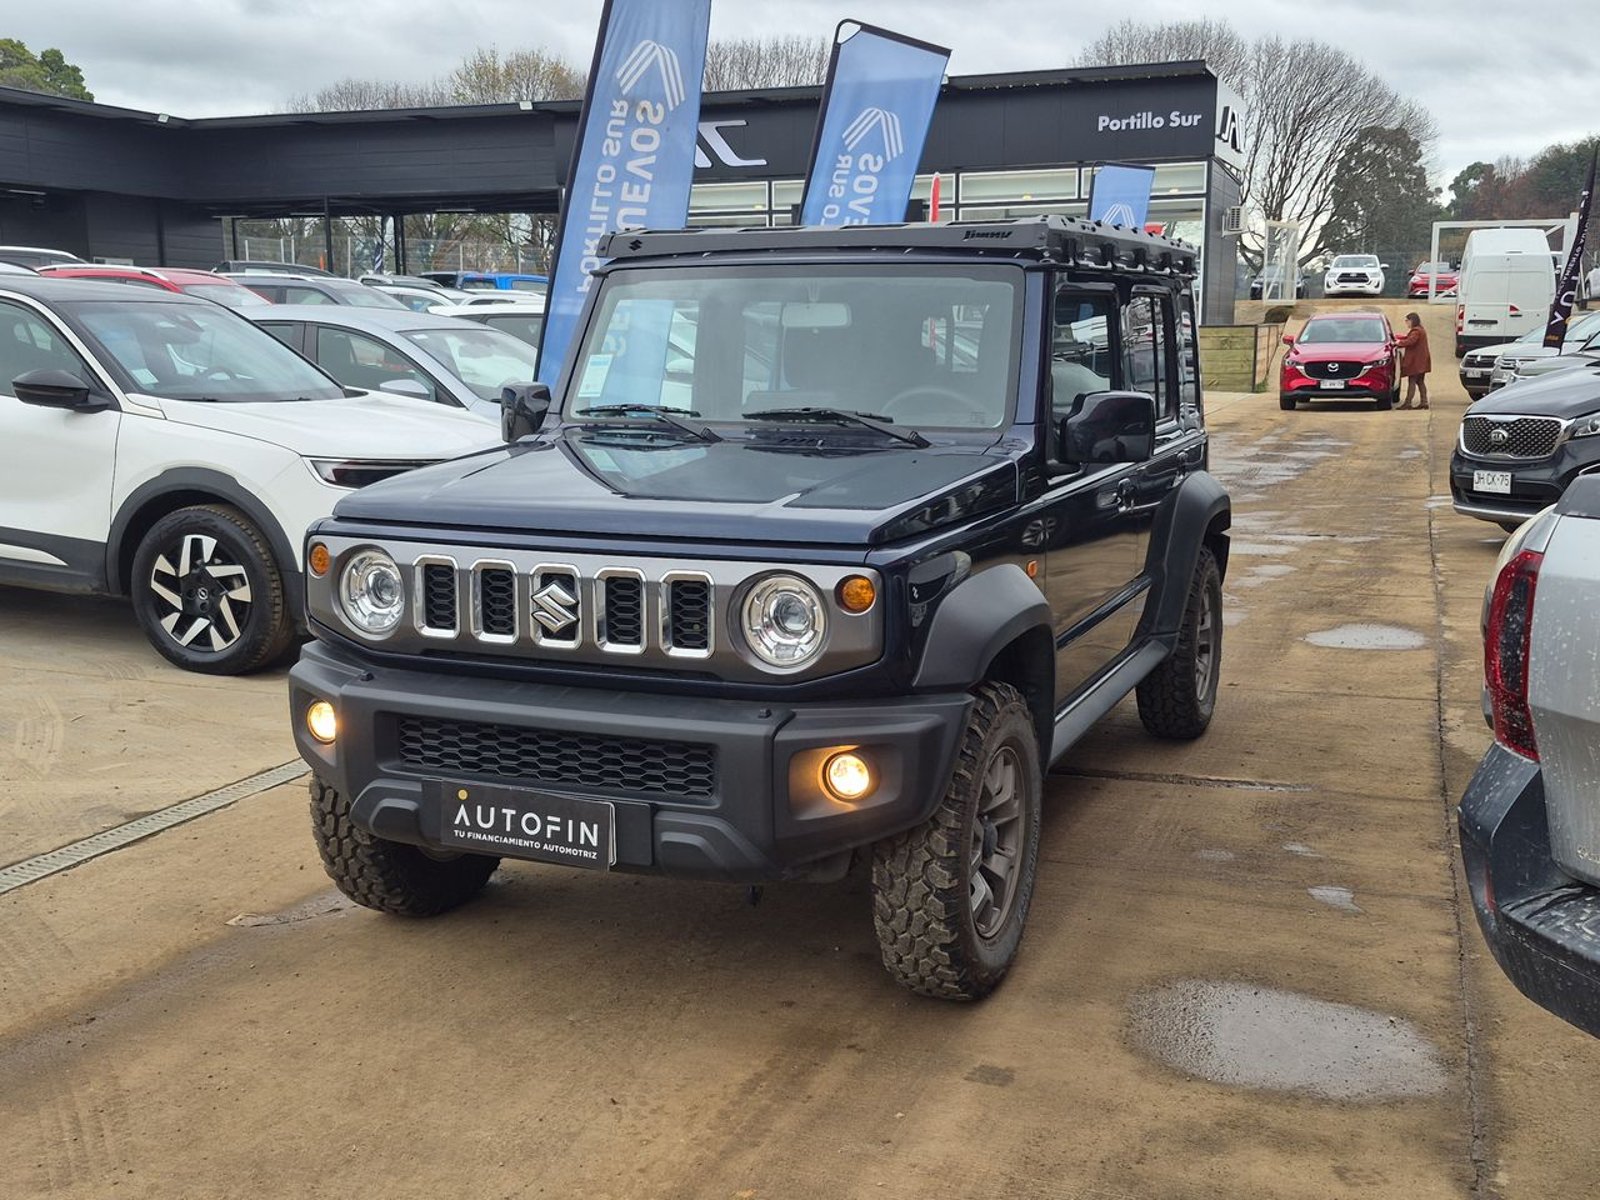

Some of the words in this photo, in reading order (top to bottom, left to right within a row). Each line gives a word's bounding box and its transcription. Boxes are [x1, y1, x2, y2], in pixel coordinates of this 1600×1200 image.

[1098, 111, 1165, 131] Portillo
[1169, 111, 1202, 127] Sur
[454, 804, 598, 847] AUTOFIN
[454, 829, 465, 838] TU
[467, 831, 541, 849] FINANCIAMIENTO
[542, 843, 598, 860] AUTOMOTRIZ
